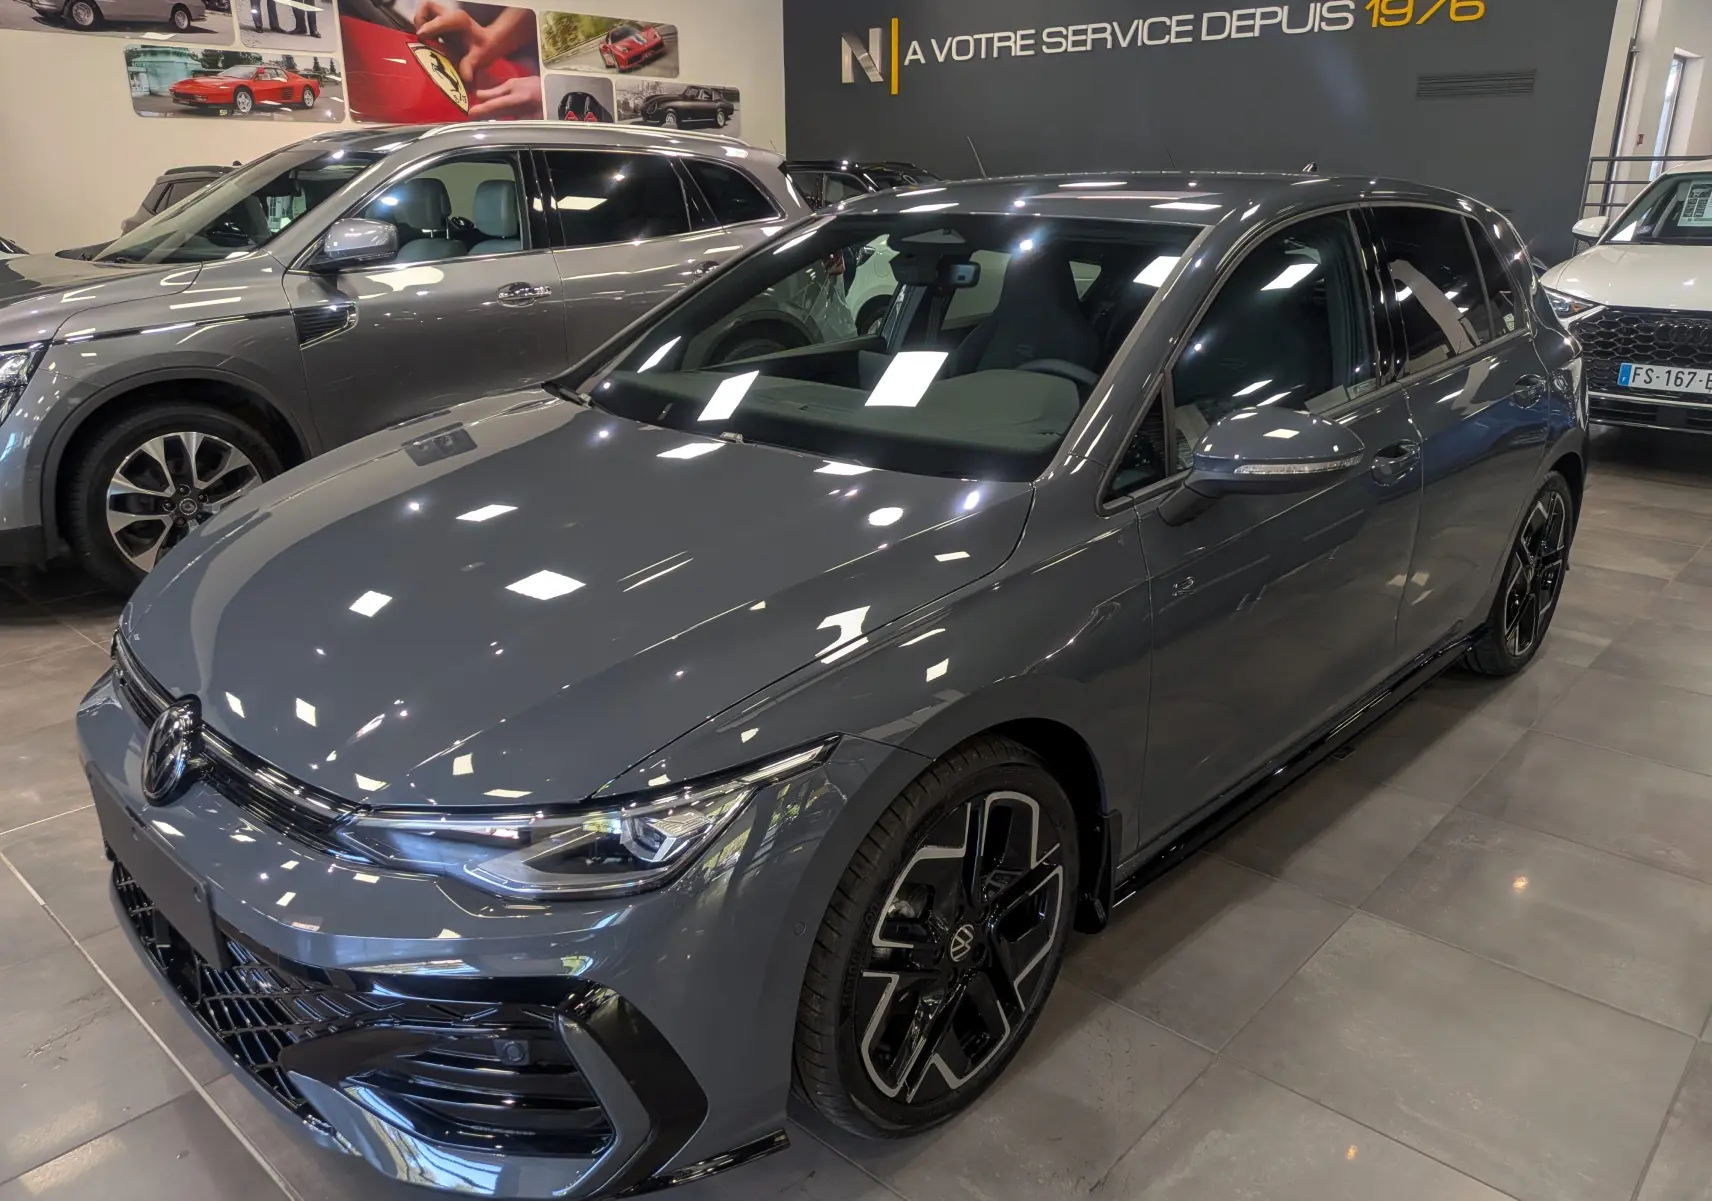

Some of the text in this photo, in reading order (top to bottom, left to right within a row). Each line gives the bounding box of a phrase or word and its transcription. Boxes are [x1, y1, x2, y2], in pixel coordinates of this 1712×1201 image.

[904, 40, 926, 66] A
[931, 30, 1036, 63] VOTRE
[1042, 14, 1195, 54] SERVICE
[1201, 0, 1355, 41] DEPUIS
